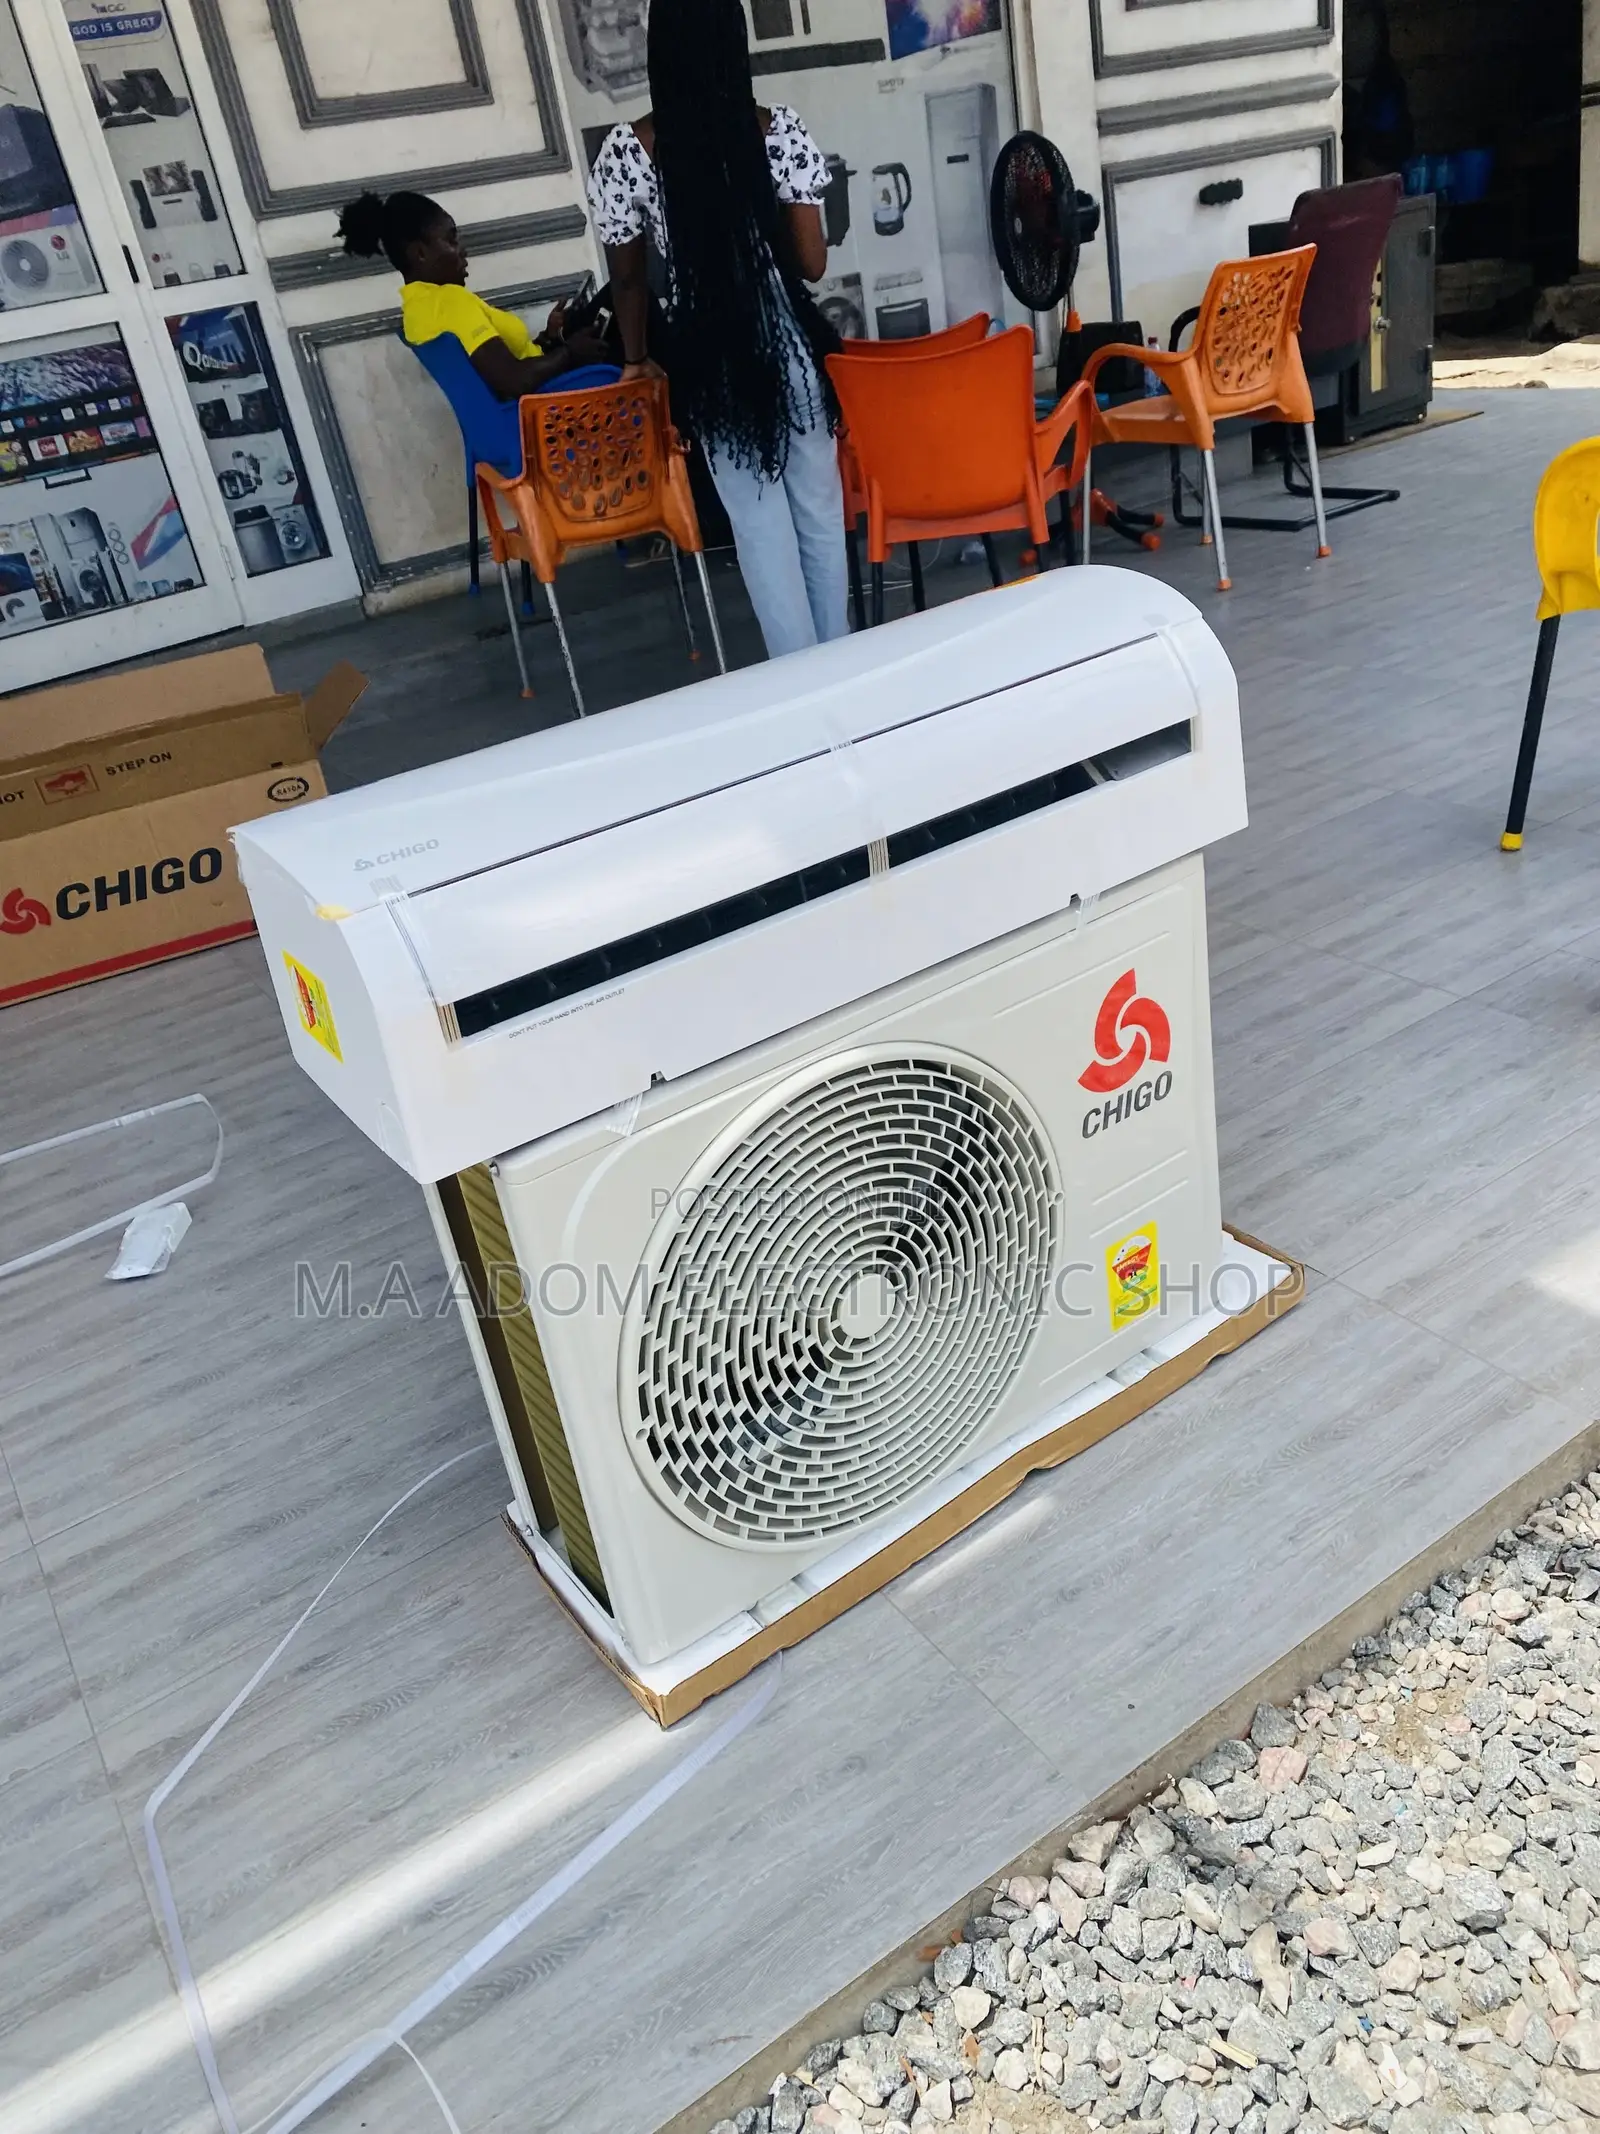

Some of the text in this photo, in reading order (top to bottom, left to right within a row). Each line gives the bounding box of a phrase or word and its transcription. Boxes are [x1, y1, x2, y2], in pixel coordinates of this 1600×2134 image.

[72, 16, 156, 35] GOD IS GREAT
[105, 757, 145, 776] STEP
[149, 751, 172, 764] ON
[376, 839, 440, 865] CHIGO
[55, 847, 223, 920] CHIGO
[555, 1010, 570, 1020] HAND
[570, 1004, 584, 1014] INTO
[1082, 1070, 1172, 1139] CHIGO
